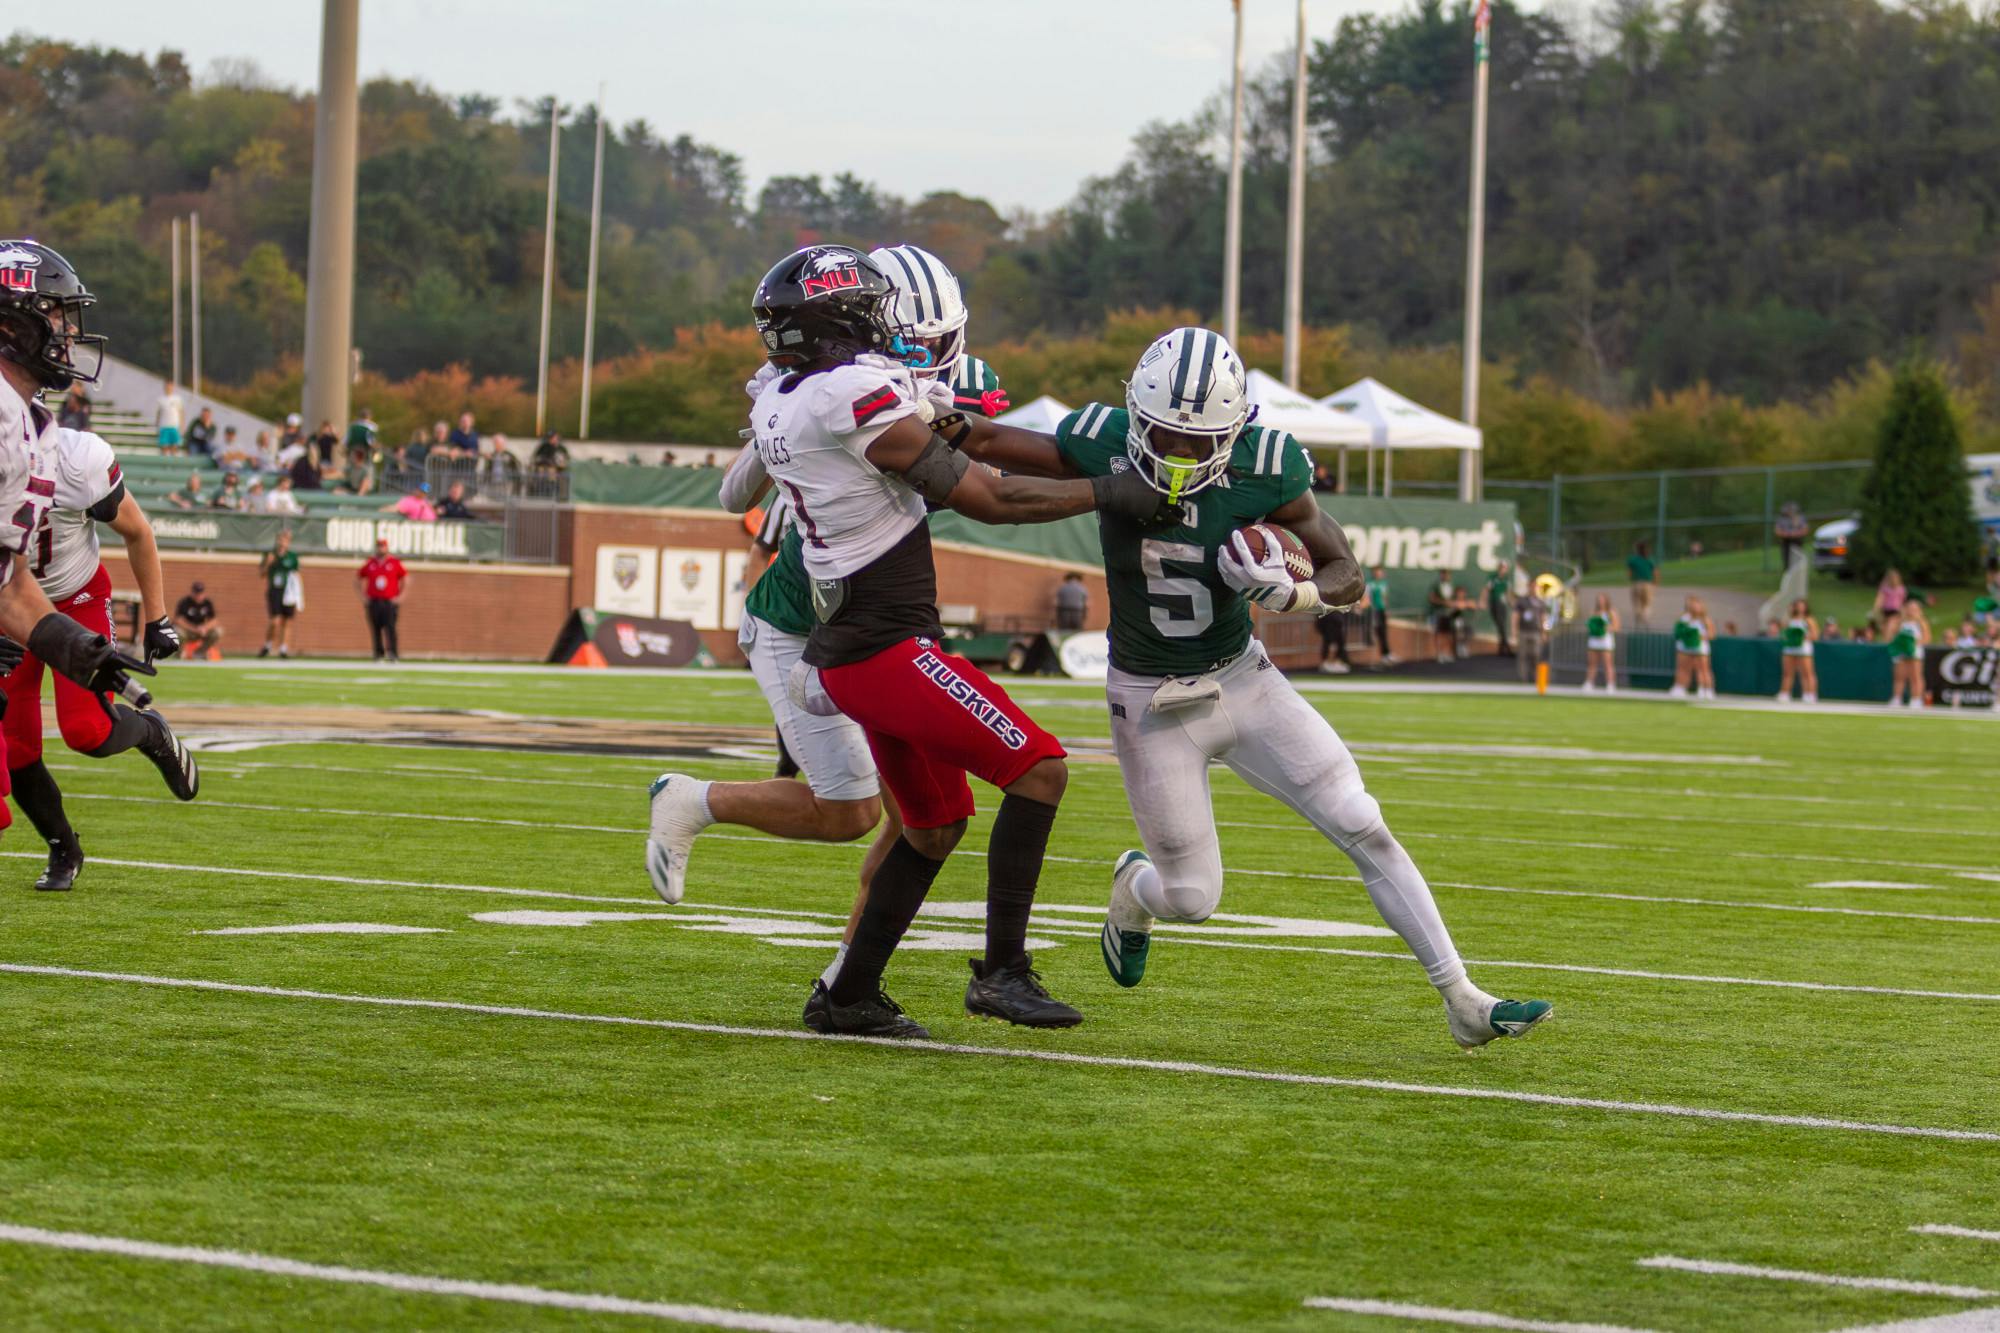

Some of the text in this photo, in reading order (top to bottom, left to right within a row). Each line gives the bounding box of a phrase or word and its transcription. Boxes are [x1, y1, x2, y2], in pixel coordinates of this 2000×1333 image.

[804, 268, 859, 297] NIU
[326, 518, 468, 555] OHIO FOOTBALL
[783, 480, 829, 549] 1
[1141, 537, 1214, 637] 5
[912, 650, 1028, 750] HUSKIES
